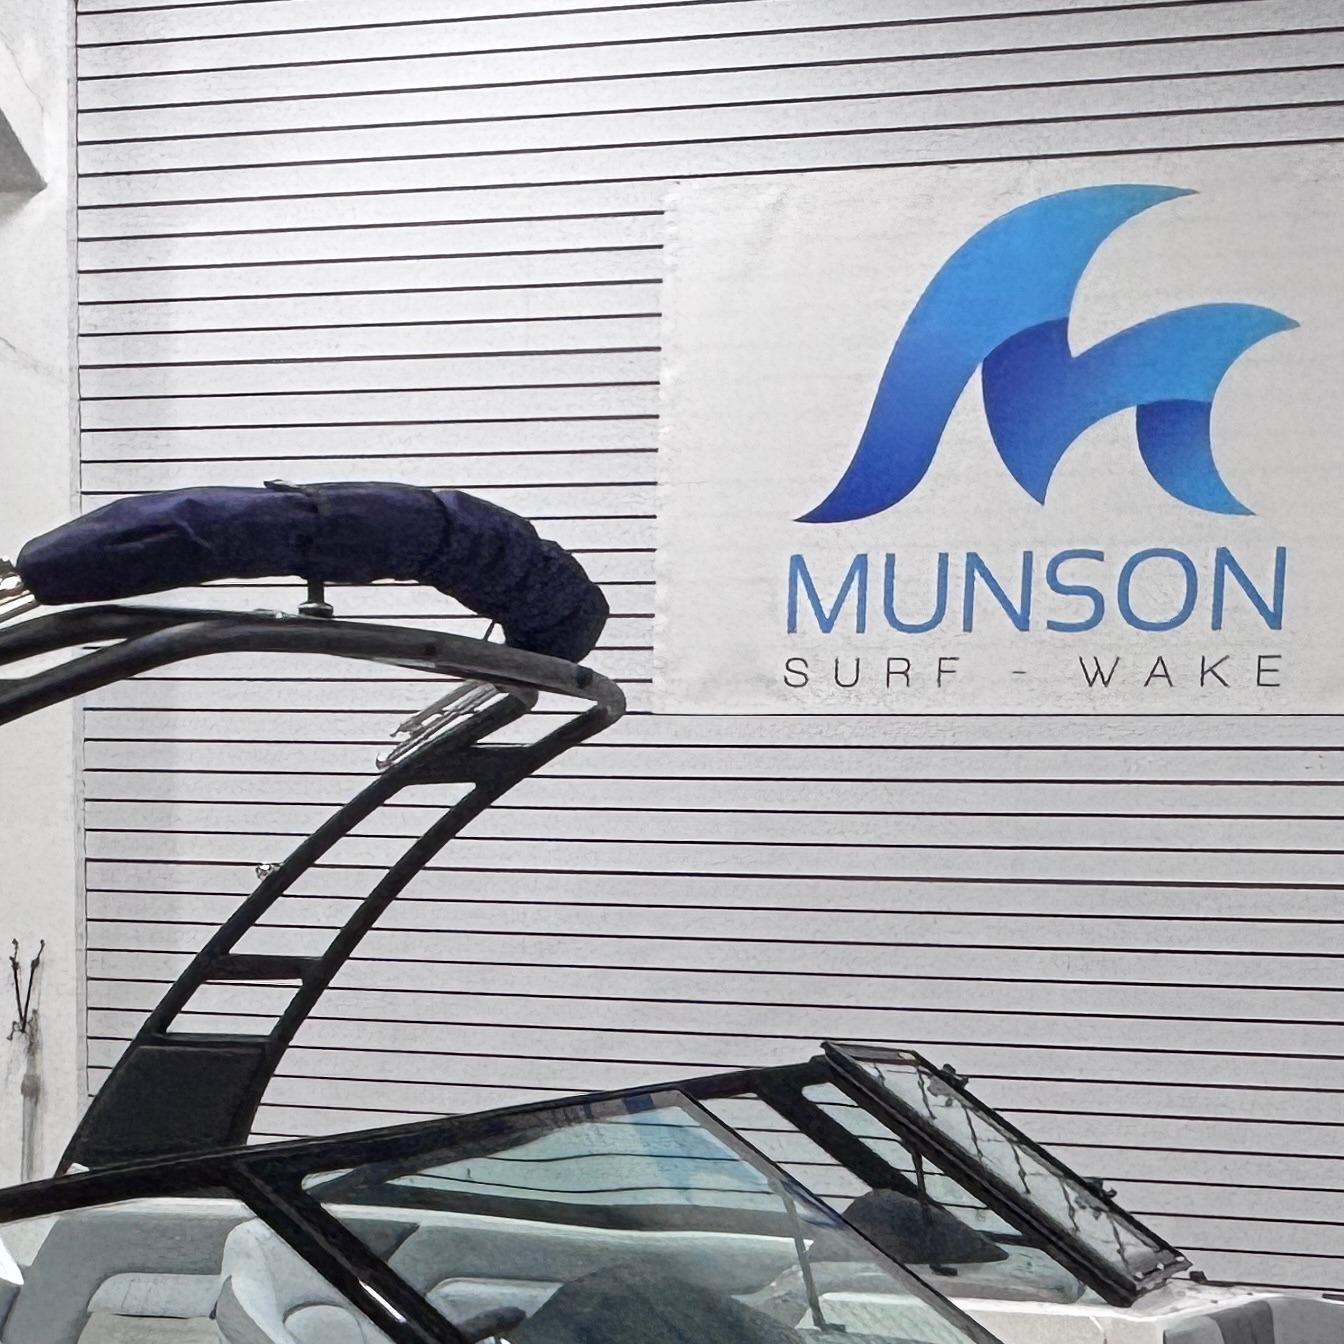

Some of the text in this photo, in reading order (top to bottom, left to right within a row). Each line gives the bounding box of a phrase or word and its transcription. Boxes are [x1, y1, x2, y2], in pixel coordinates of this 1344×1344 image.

[786, 546, 1287, 634] MUNSON
[783, 656, 961, 689] SURF
[1078, 654, 1284, 689] WAKE
